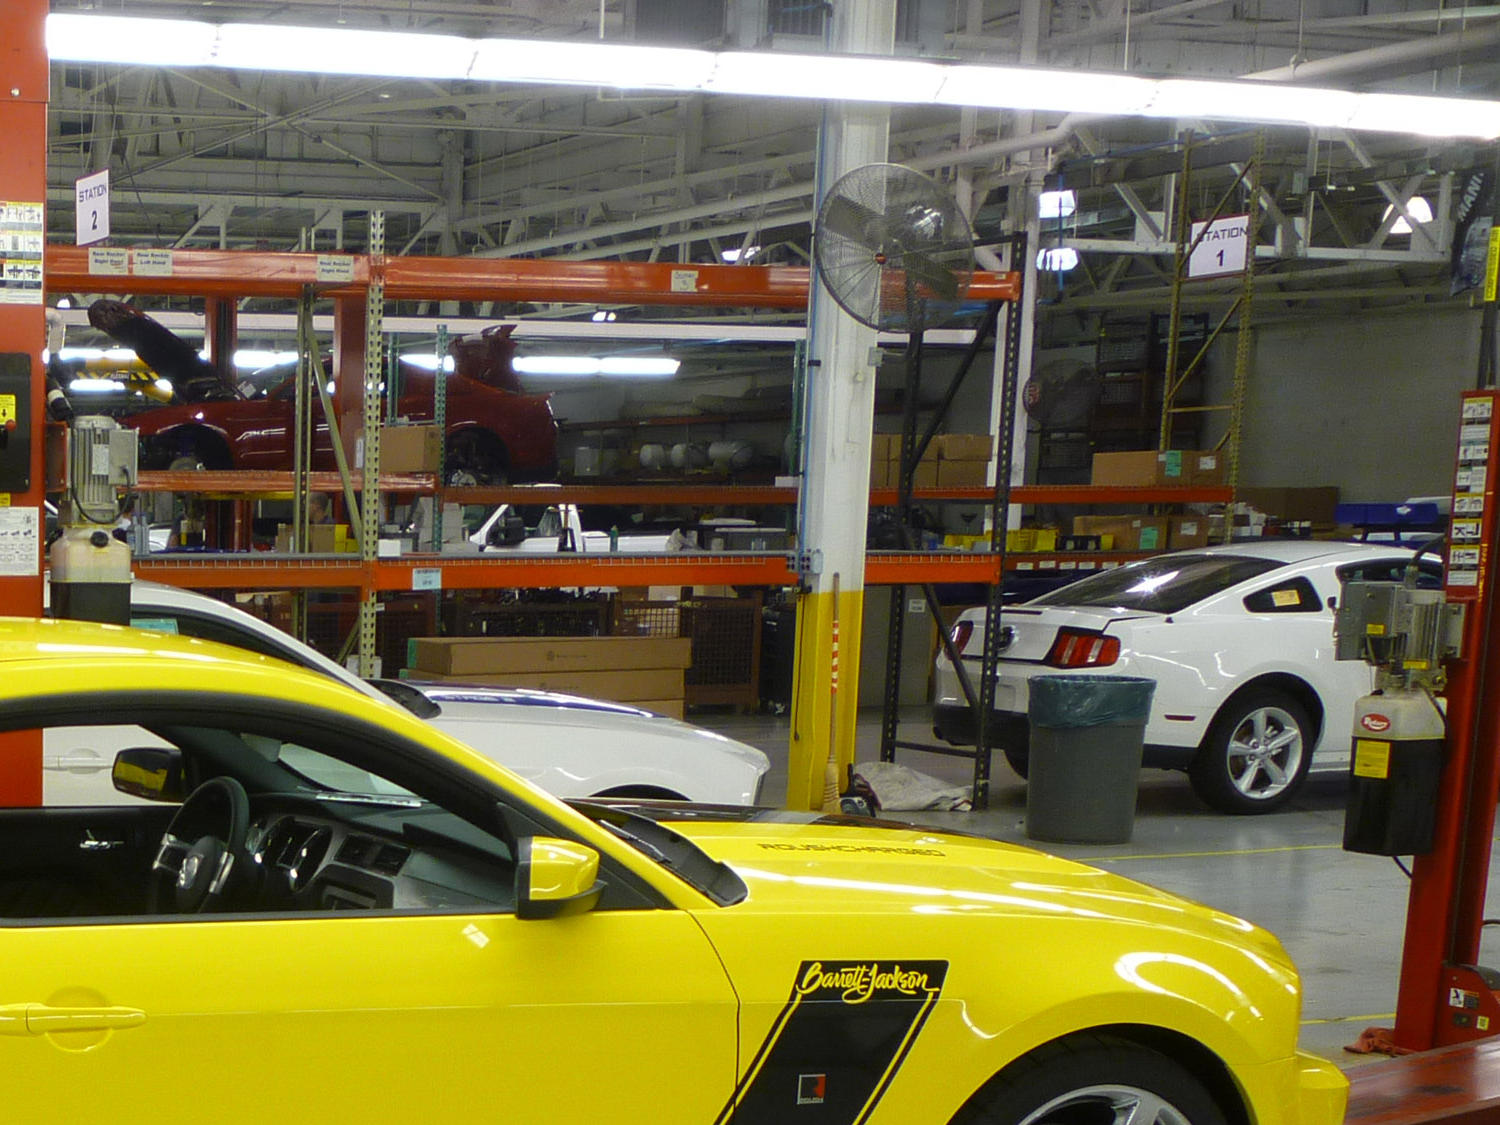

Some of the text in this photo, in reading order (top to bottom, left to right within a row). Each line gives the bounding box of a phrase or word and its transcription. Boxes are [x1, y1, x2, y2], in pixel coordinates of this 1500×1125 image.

[79, 184, 107, 202] STATION
[92, 210, 98, 230] 2
[1216, 249, 1224, 267] 1
[757, 843, 947, 857] ROUSHCHARGED
[796, 962, 941, 1004] Barrett-Jackson
